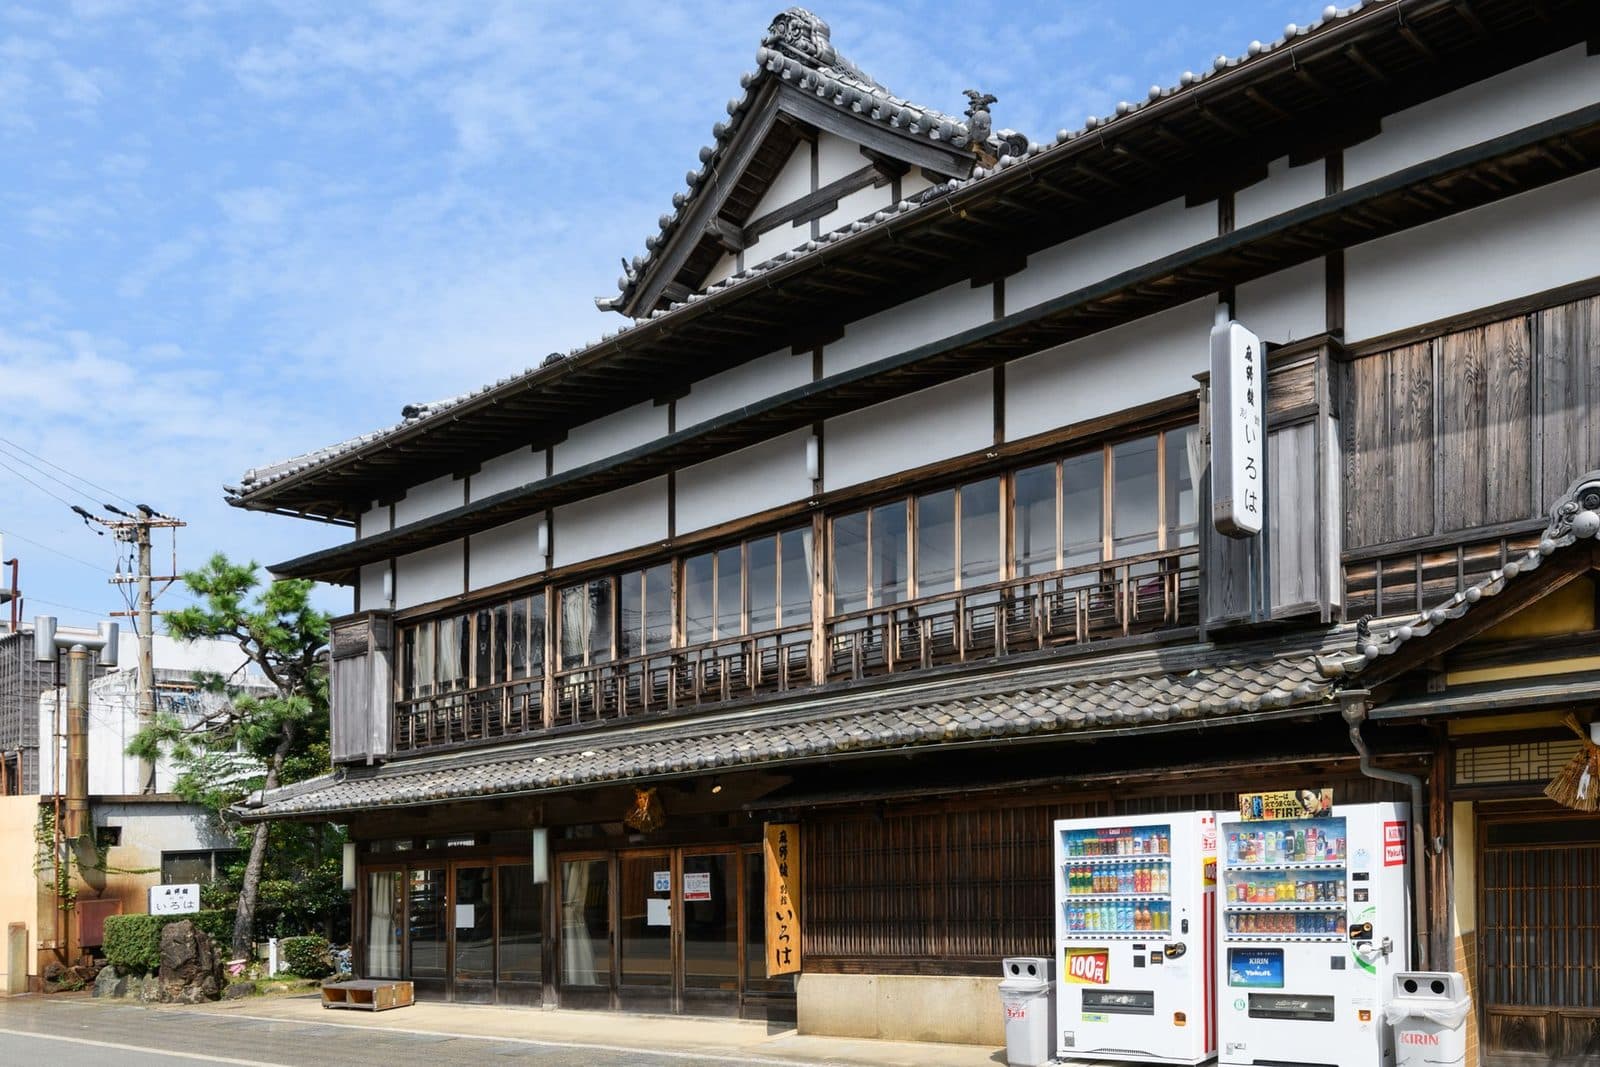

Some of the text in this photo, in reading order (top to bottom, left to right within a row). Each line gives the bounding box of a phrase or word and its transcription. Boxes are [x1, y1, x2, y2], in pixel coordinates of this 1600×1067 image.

[1244, 424, 1258, 514] いろは
[1275, 808, 1300, 818] FIRE
[156, 901, 195, 911] いろは
[776, 909, 793, 968] いろは
[1249, 957, 1270, 965] KIRIN
[1245, 969, 1272, 977] Yakult
[1400, 1032, 1439, 1046] KIRIN
